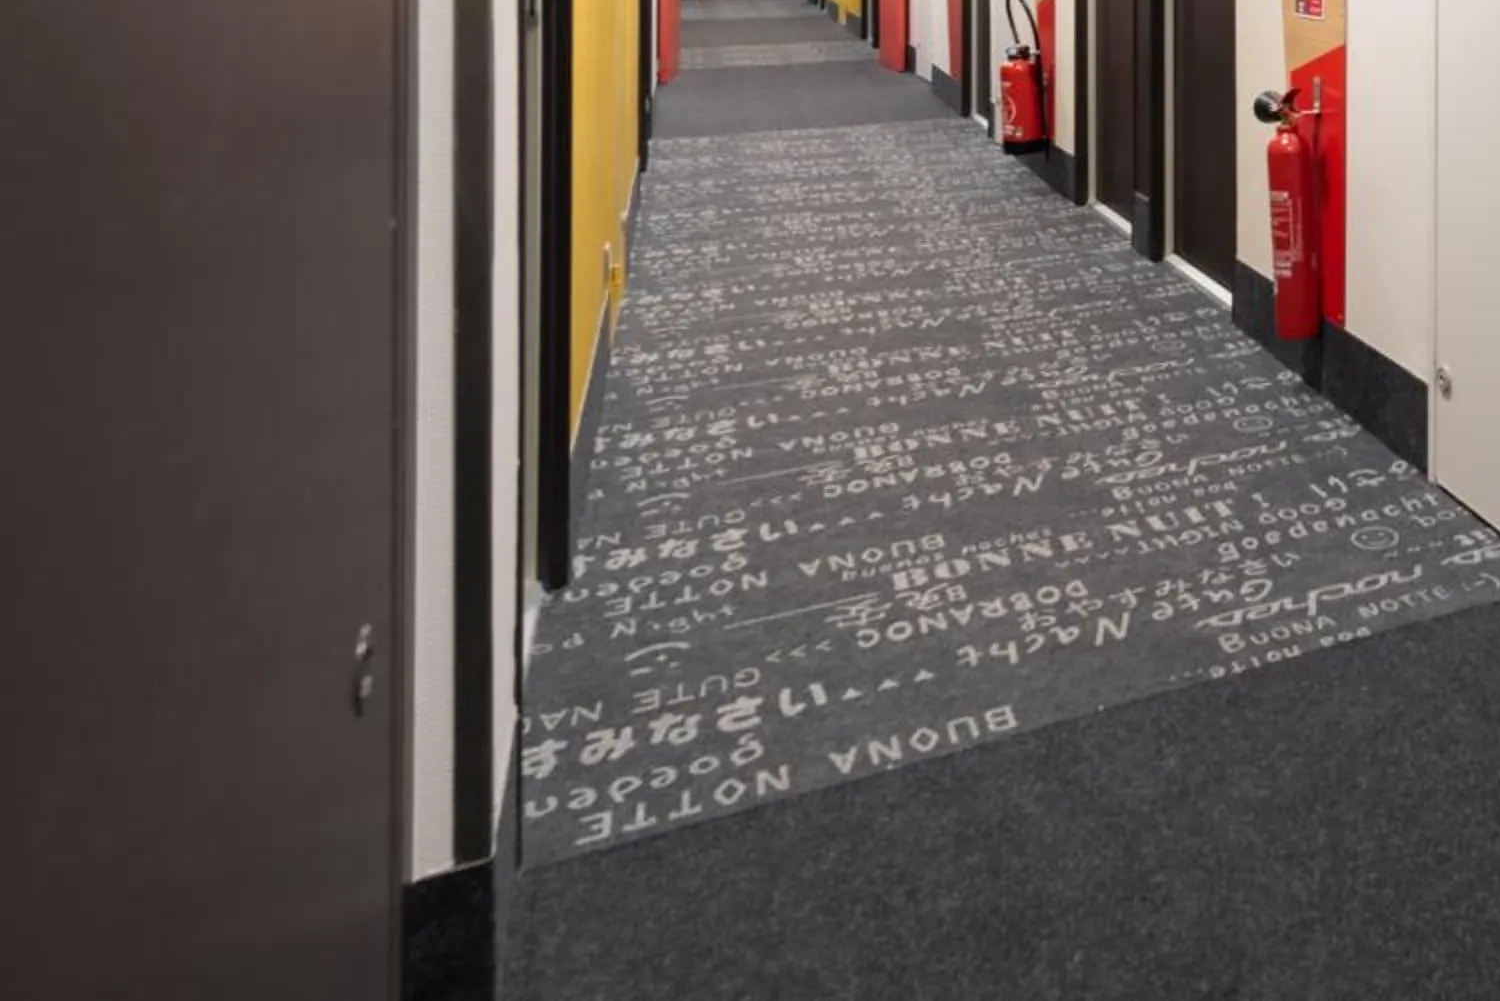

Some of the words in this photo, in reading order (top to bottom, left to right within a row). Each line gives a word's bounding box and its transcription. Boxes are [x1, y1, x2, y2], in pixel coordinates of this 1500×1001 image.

[799, 534, 945, 576] BUONA
[892, 532, 1093, 590] BONNE
[1106, 499, 1232, 541] NUIT
[605, 571, 768, 617] NOTTE
[857, 579, 1088, 648] DOBRANOC
[1152, 578, 1273, 620] Gute
[957, 612, 1130, 666] Nacht
[632, 667, 761, 713] GUTE
[523, 701, 602, 734] NA
[829, 705, 1017, 774] BUONA
[524, 733, 764, 818] goeden
[575, 764, 790, 845] NOTTE
